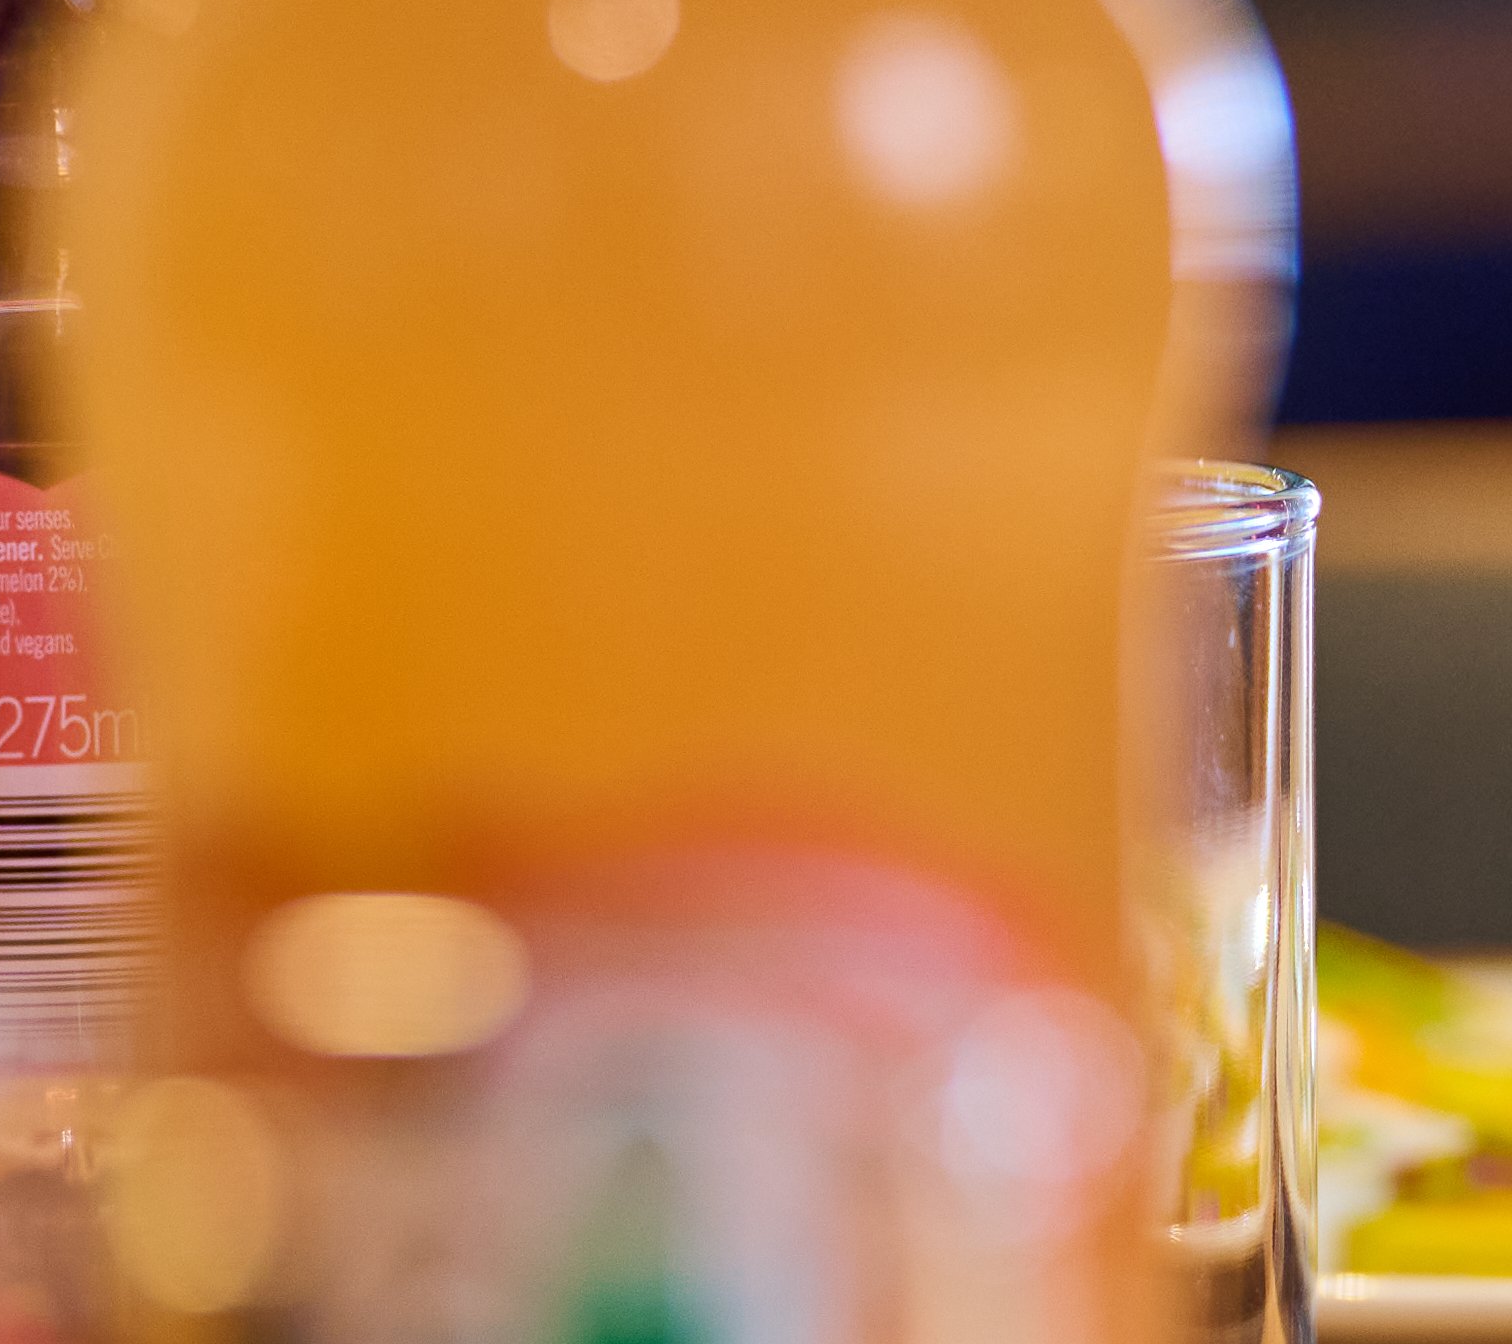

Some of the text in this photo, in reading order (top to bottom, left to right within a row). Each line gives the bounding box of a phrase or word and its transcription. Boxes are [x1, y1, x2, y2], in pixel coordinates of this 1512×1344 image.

[14, 509, 74, 530] senses.
[49, 534, 95, 561] Serve
[48, 566, 88, 593] 2%).
[13, 632, 79, 659] vegans.
